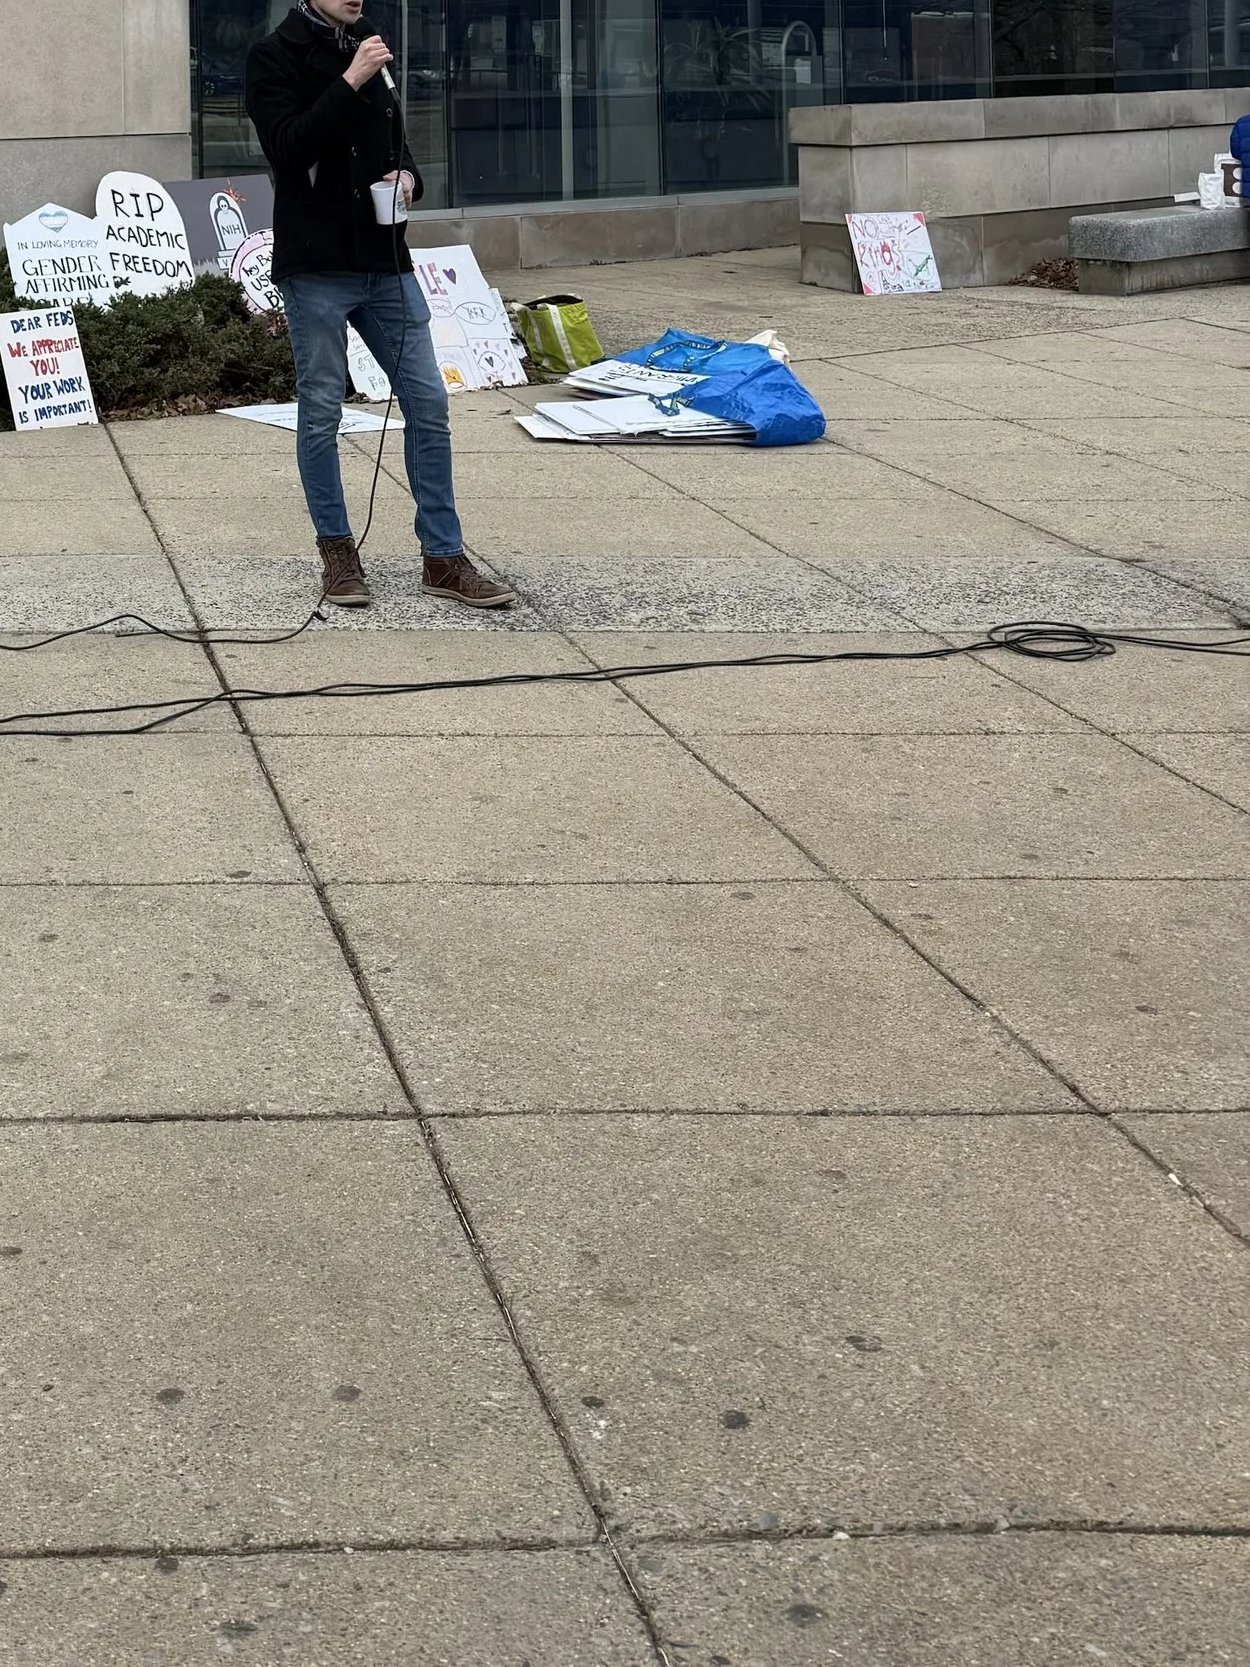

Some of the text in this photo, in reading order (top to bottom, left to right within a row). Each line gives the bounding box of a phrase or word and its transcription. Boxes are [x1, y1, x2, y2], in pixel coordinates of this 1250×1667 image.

[110, 188, 164, 222] RIP
[105, 224, 186, 250] ACADEMIC
[221, 223, 242, 236] NIH
[17, 239, 99, 251] IN LOVING MEMORY
[21, 255, 102, 276] GENDER
[109, 251, 193, 278] FREEDOM
[25, 274, 110, 294] AFFIRMING
[37, 296, 89, 308] AR
[10, 310, 74, 334] DEAR FEDS
[30, 356, 61, 377] YOU!
[17, 375, 86, 404] YOUR WORK
[18, 398, 93, 425] IS IMPORTANT!
